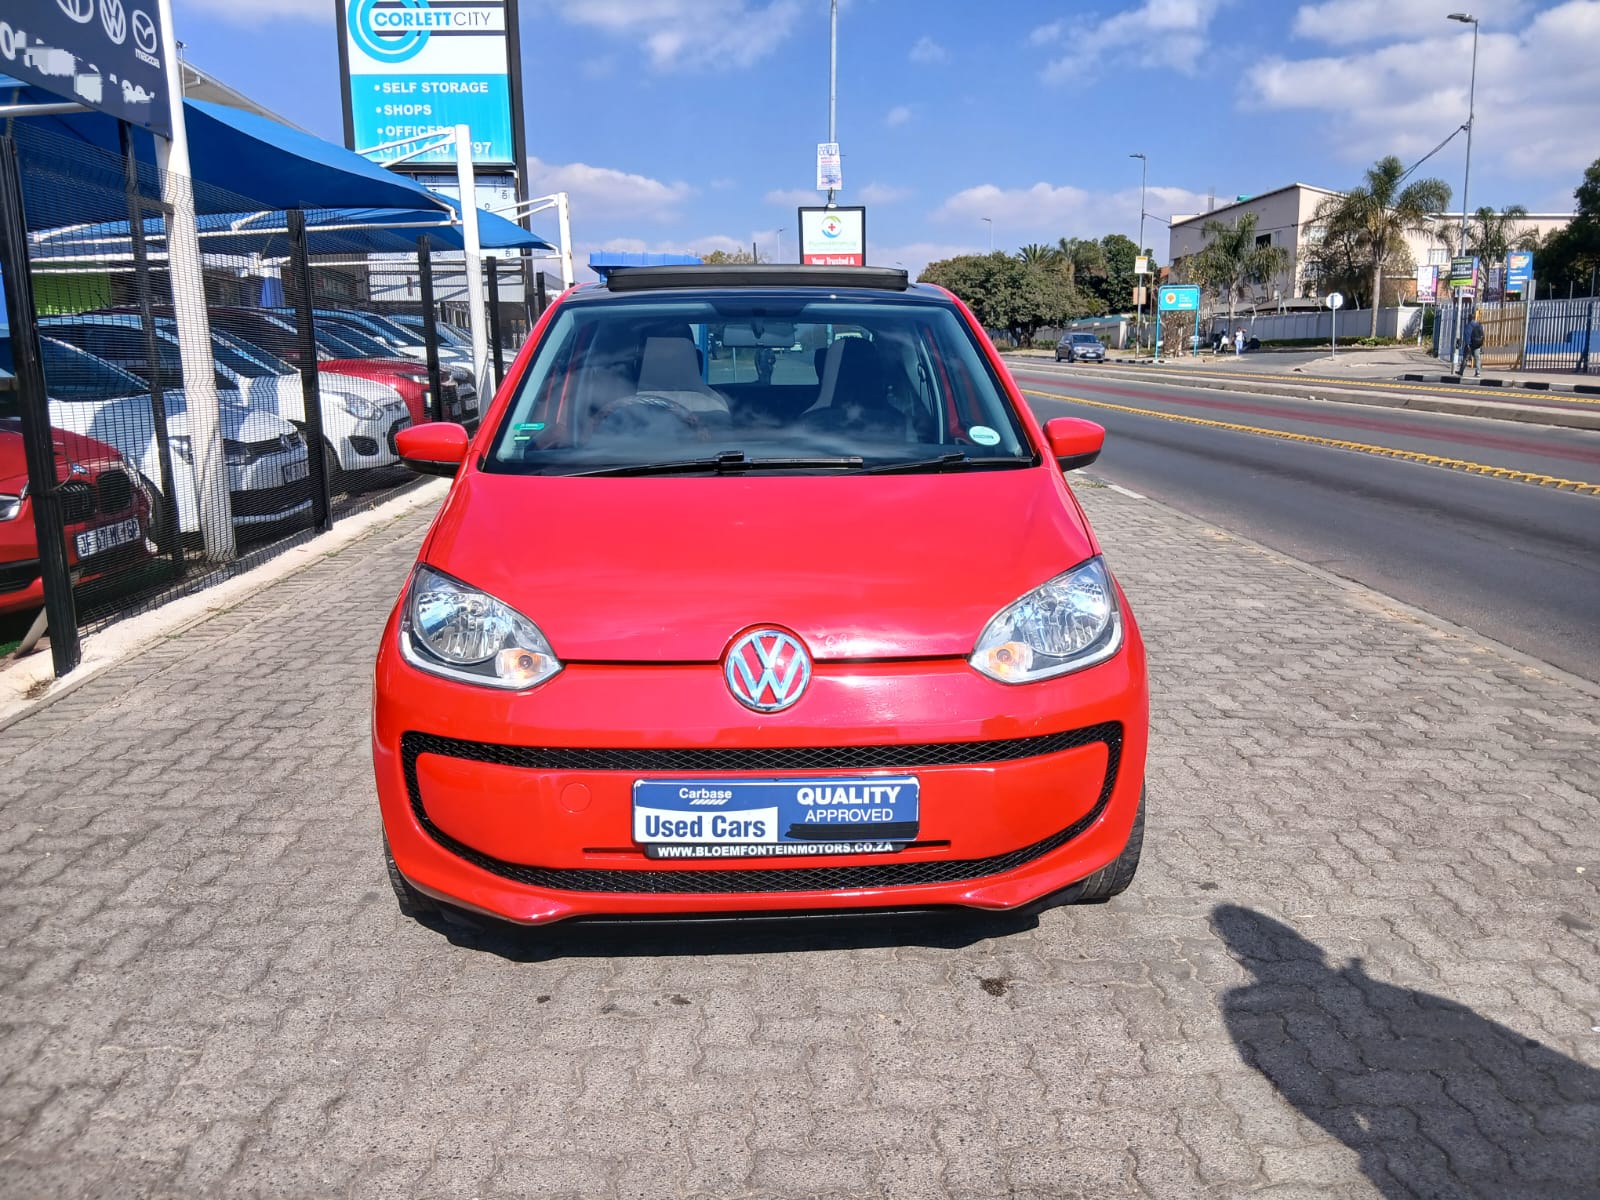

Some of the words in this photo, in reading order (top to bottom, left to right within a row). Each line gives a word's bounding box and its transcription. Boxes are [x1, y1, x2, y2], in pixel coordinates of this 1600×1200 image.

[382, 82, 417, 94] SELF
[421, 81, 489, 93] STORAGE
[383, 104, 432, 116] SHOPS
[679, 788, 733, 799] Carbase
[796, 786, 901, 806] QUALITY
[804, 808, 894, 822] APPROVED
[645, 815, 703, 838] Used
[711, 815, 766, 838] Cars
[657, 842, 894, 857] WWW.BLOEMFONTEINMOTORS.CO.ZA
